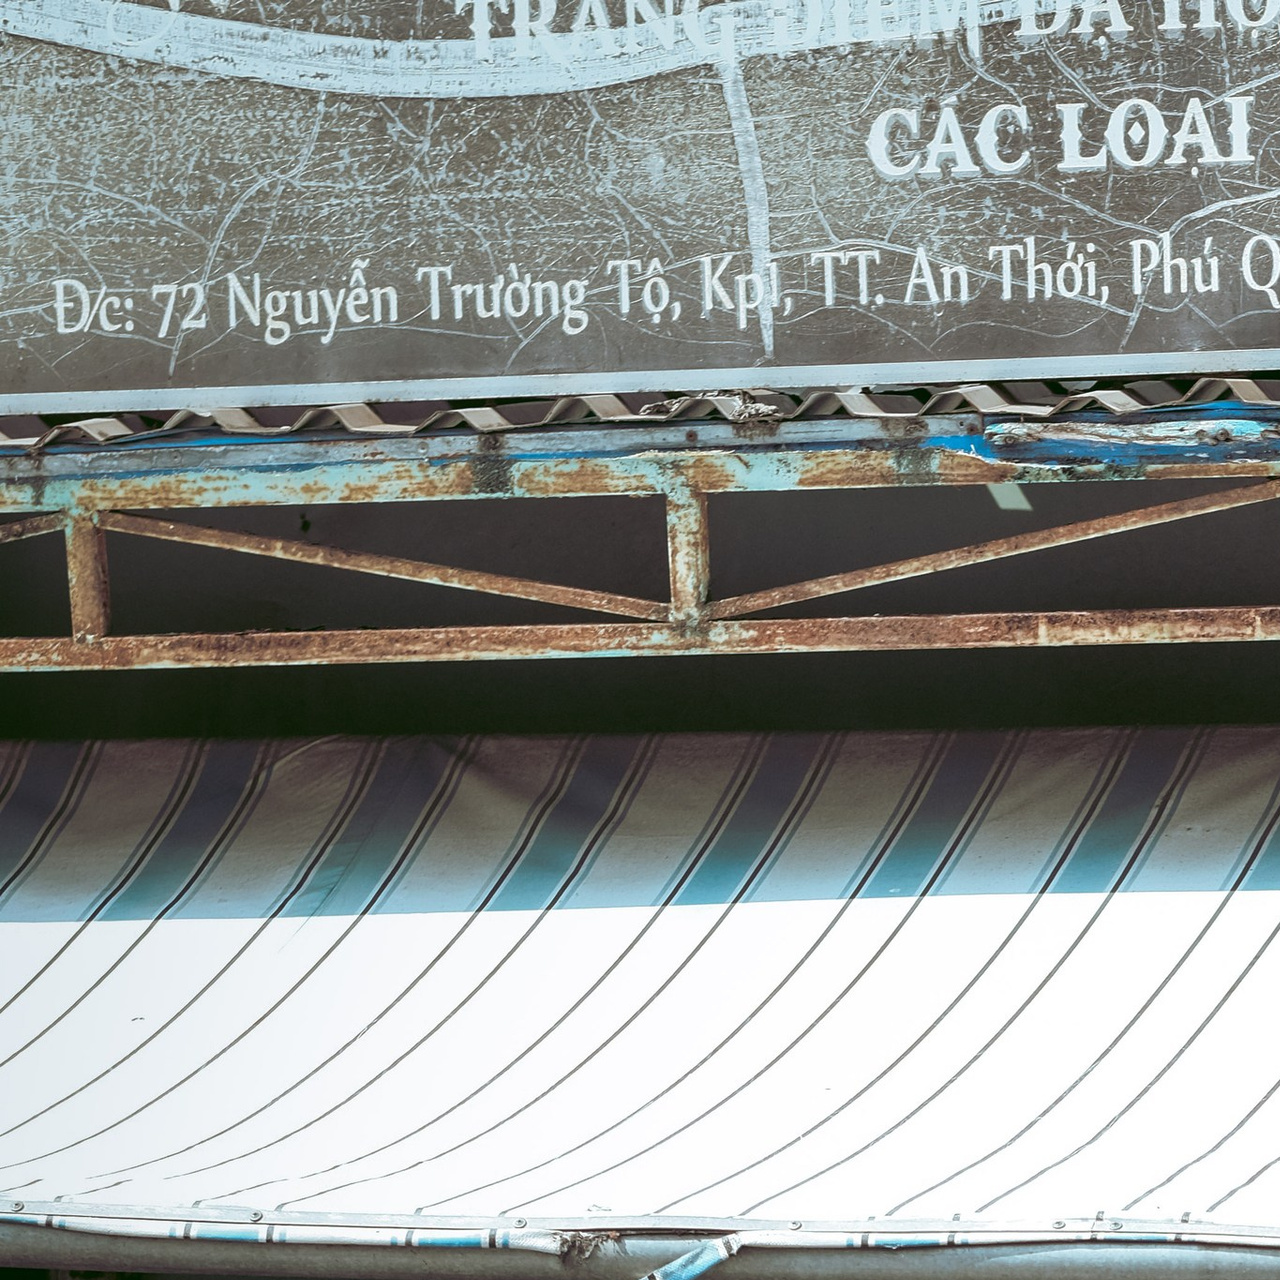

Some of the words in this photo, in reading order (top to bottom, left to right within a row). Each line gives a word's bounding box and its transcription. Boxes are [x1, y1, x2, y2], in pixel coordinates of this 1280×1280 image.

[867, 96, 1031, 180] CÁC
[1056, 97, 1256, 177] LOẠI
[54, 279, 134, 334] Đ/c:
[152, 283, 207, 337] 72
[227, 258, 399, 345] Nguyễn
[416, 263, 590, 335] Trường
[607, 260, 682, 330] Tộ,
[811, 251, 884, 306] TT.
[904, 246, 969, 305] An
[990, 238, 1109, 305] Thới,
[1131, 236, 1221, 293] Phú
